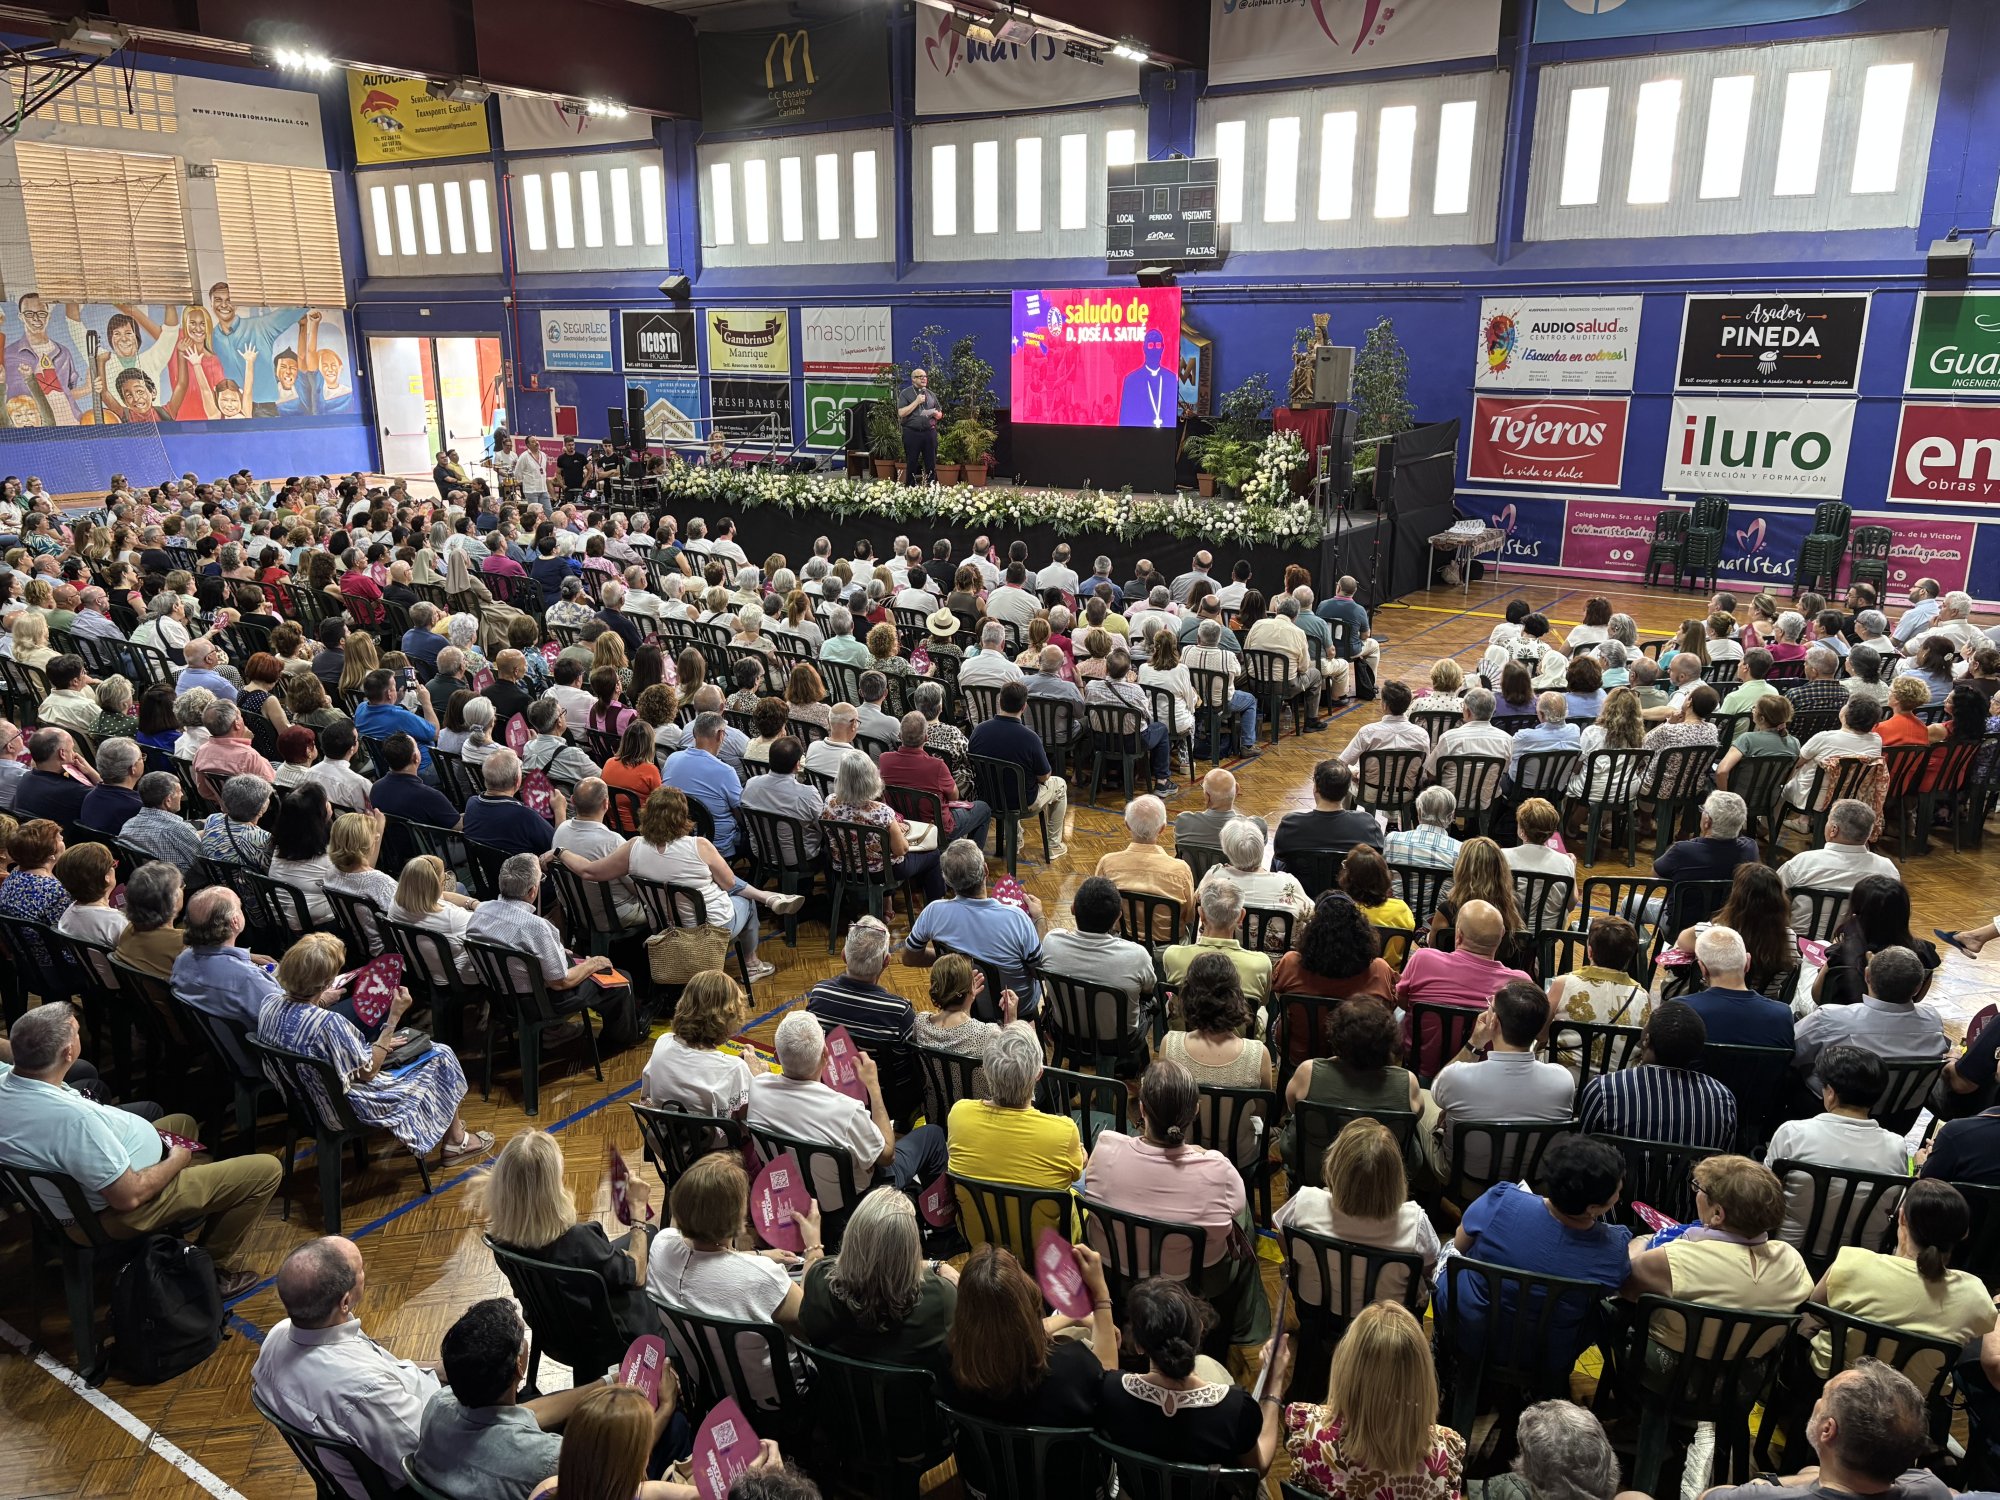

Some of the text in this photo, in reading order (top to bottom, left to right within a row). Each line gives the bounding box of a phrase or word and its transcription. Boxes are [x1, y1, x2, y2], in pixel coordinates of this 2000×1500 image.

[1116, 210, 1212, 223] LOCAL PERIODO VISITANTE
[1106, 246, 1216, 258] FALTAS FALTAS
[1065, 297, 1123, 324] saludo
[1126, 296, 1150, 324] de
[1745, 303, 1806, 323] Asador
[806, 320, 887, 346] masprint
[1065, 323, 1147, 345] D. JOSÉ A. SATUÉ
[1531, 318, 1629, 334] AUDIOsalud.es
[640, 332, 679, 354] ACOSTA
[723, 331, 773, 346] Gambrinus
[1721, 326, 1821, 347] PINEDA
[729, 348, 768, 361] Manrique
[1568, 352, 1583, 362] en
[1929, 345, 2000, 375] Gua
[1952, 378, 2000, 388] INGENIERÍ
[712, 397, 791, 409] FRESH BARBER
[1489, 413, 1608, 451] Tejeros
[1681, 415, 1832, 471] iluro
[1502, 463, 1584, 479] La vida es dulce
[1680, 470, 1747, 480] PREVENCIÓN
[1762, 473, 1828, 483] FORMACIÓN
[1927, 478, 1993, 495] obras y
[1574, 511, 1600, 520] Colegio
[1600, 512, 1618, 520] Ntra.
[1930, 532, 1962, 541] Victoria
